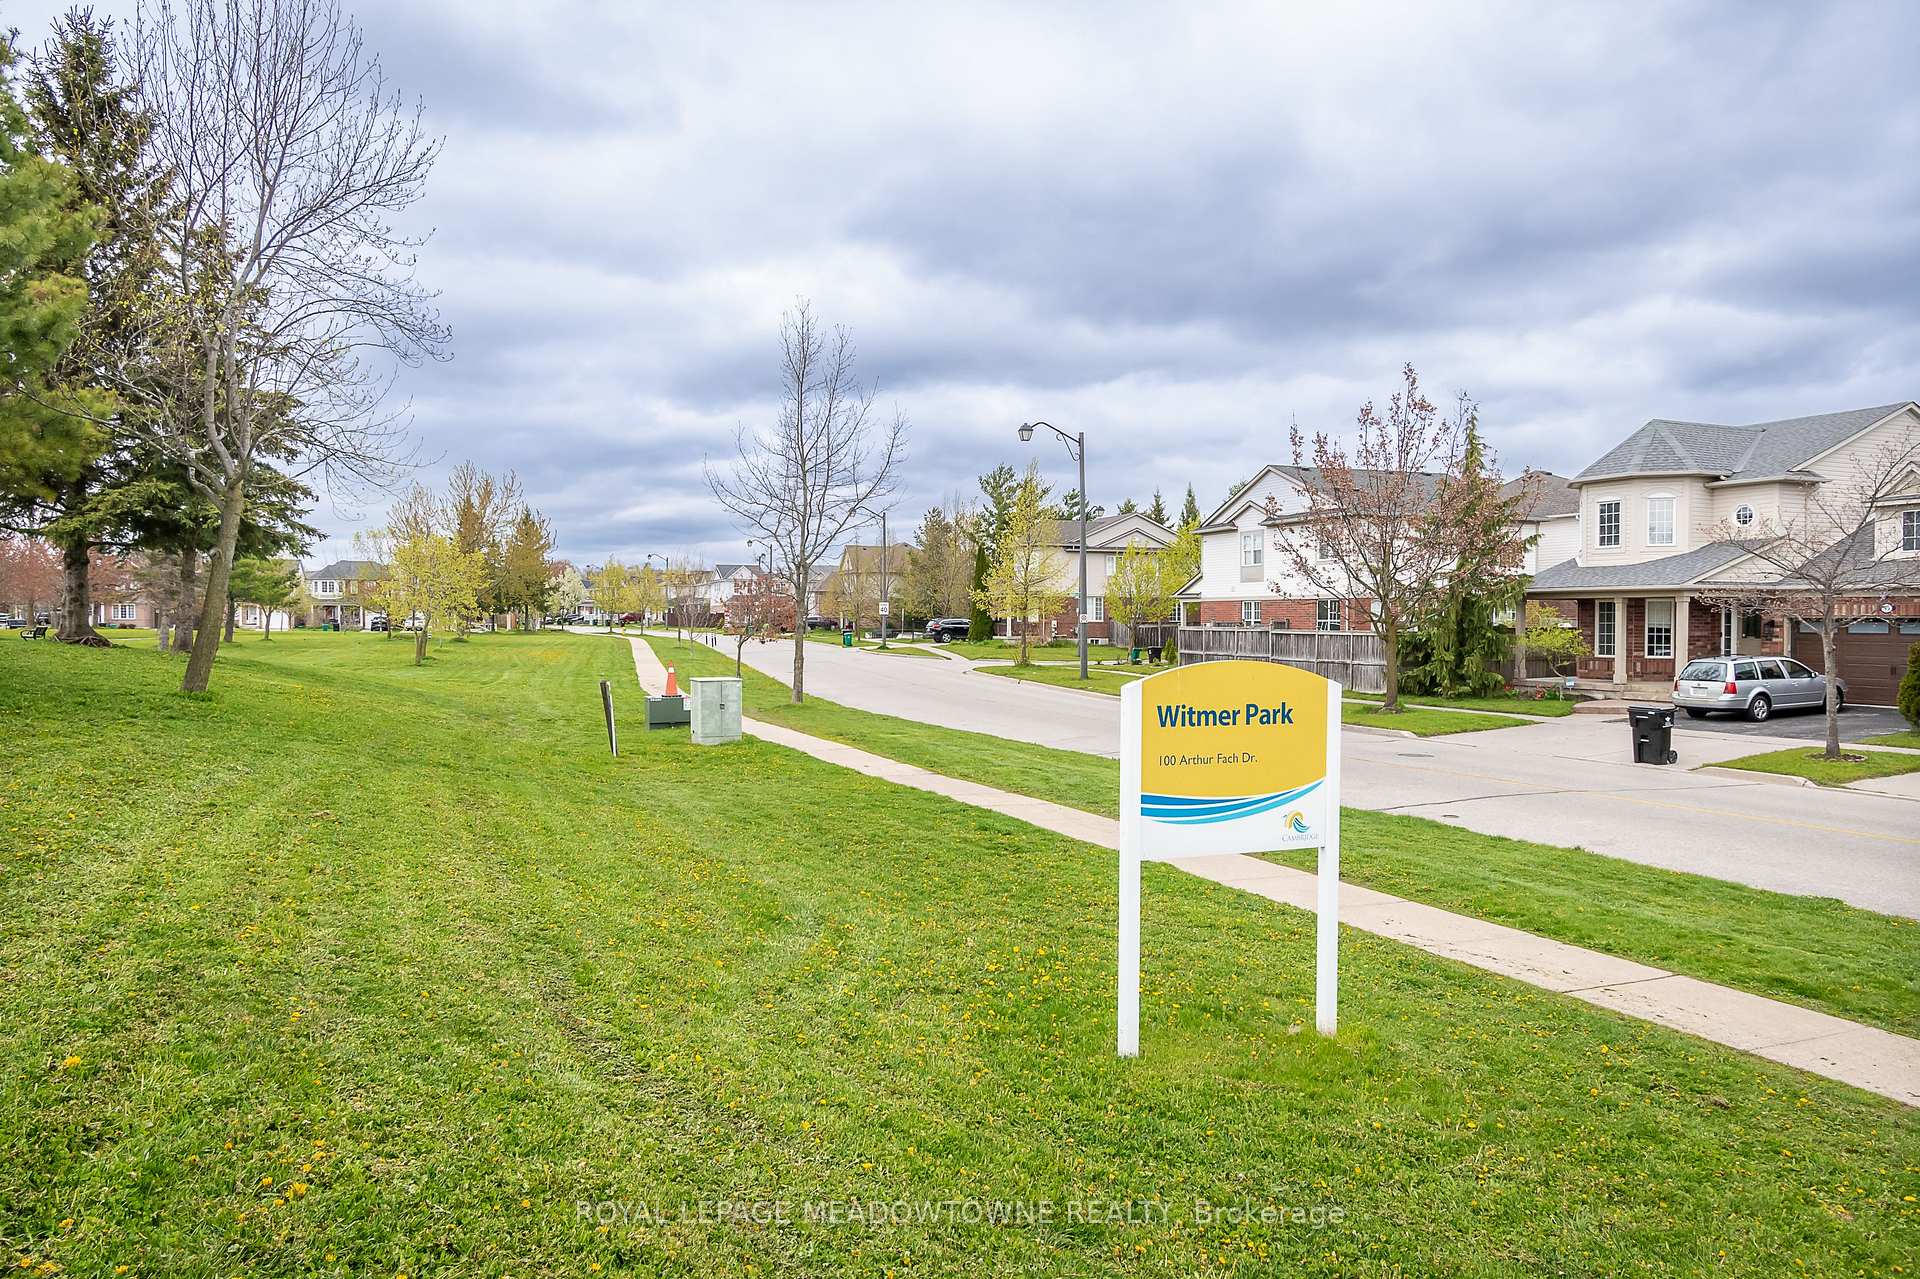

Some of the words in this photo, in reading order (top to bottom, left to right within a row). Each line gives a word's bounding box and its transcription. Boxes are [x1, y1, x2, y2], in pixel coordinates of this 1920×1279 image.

[1157, 704, 1240, 728] Witmer
[1245, 702, 1294, 726] Park
[1159, 755, 1177, 767] 100
[1179, 754, 1214, 766] Arthur
[1217, 753, 1239, 764] Fach
[1242, 752, 1258, 763] Dr.
